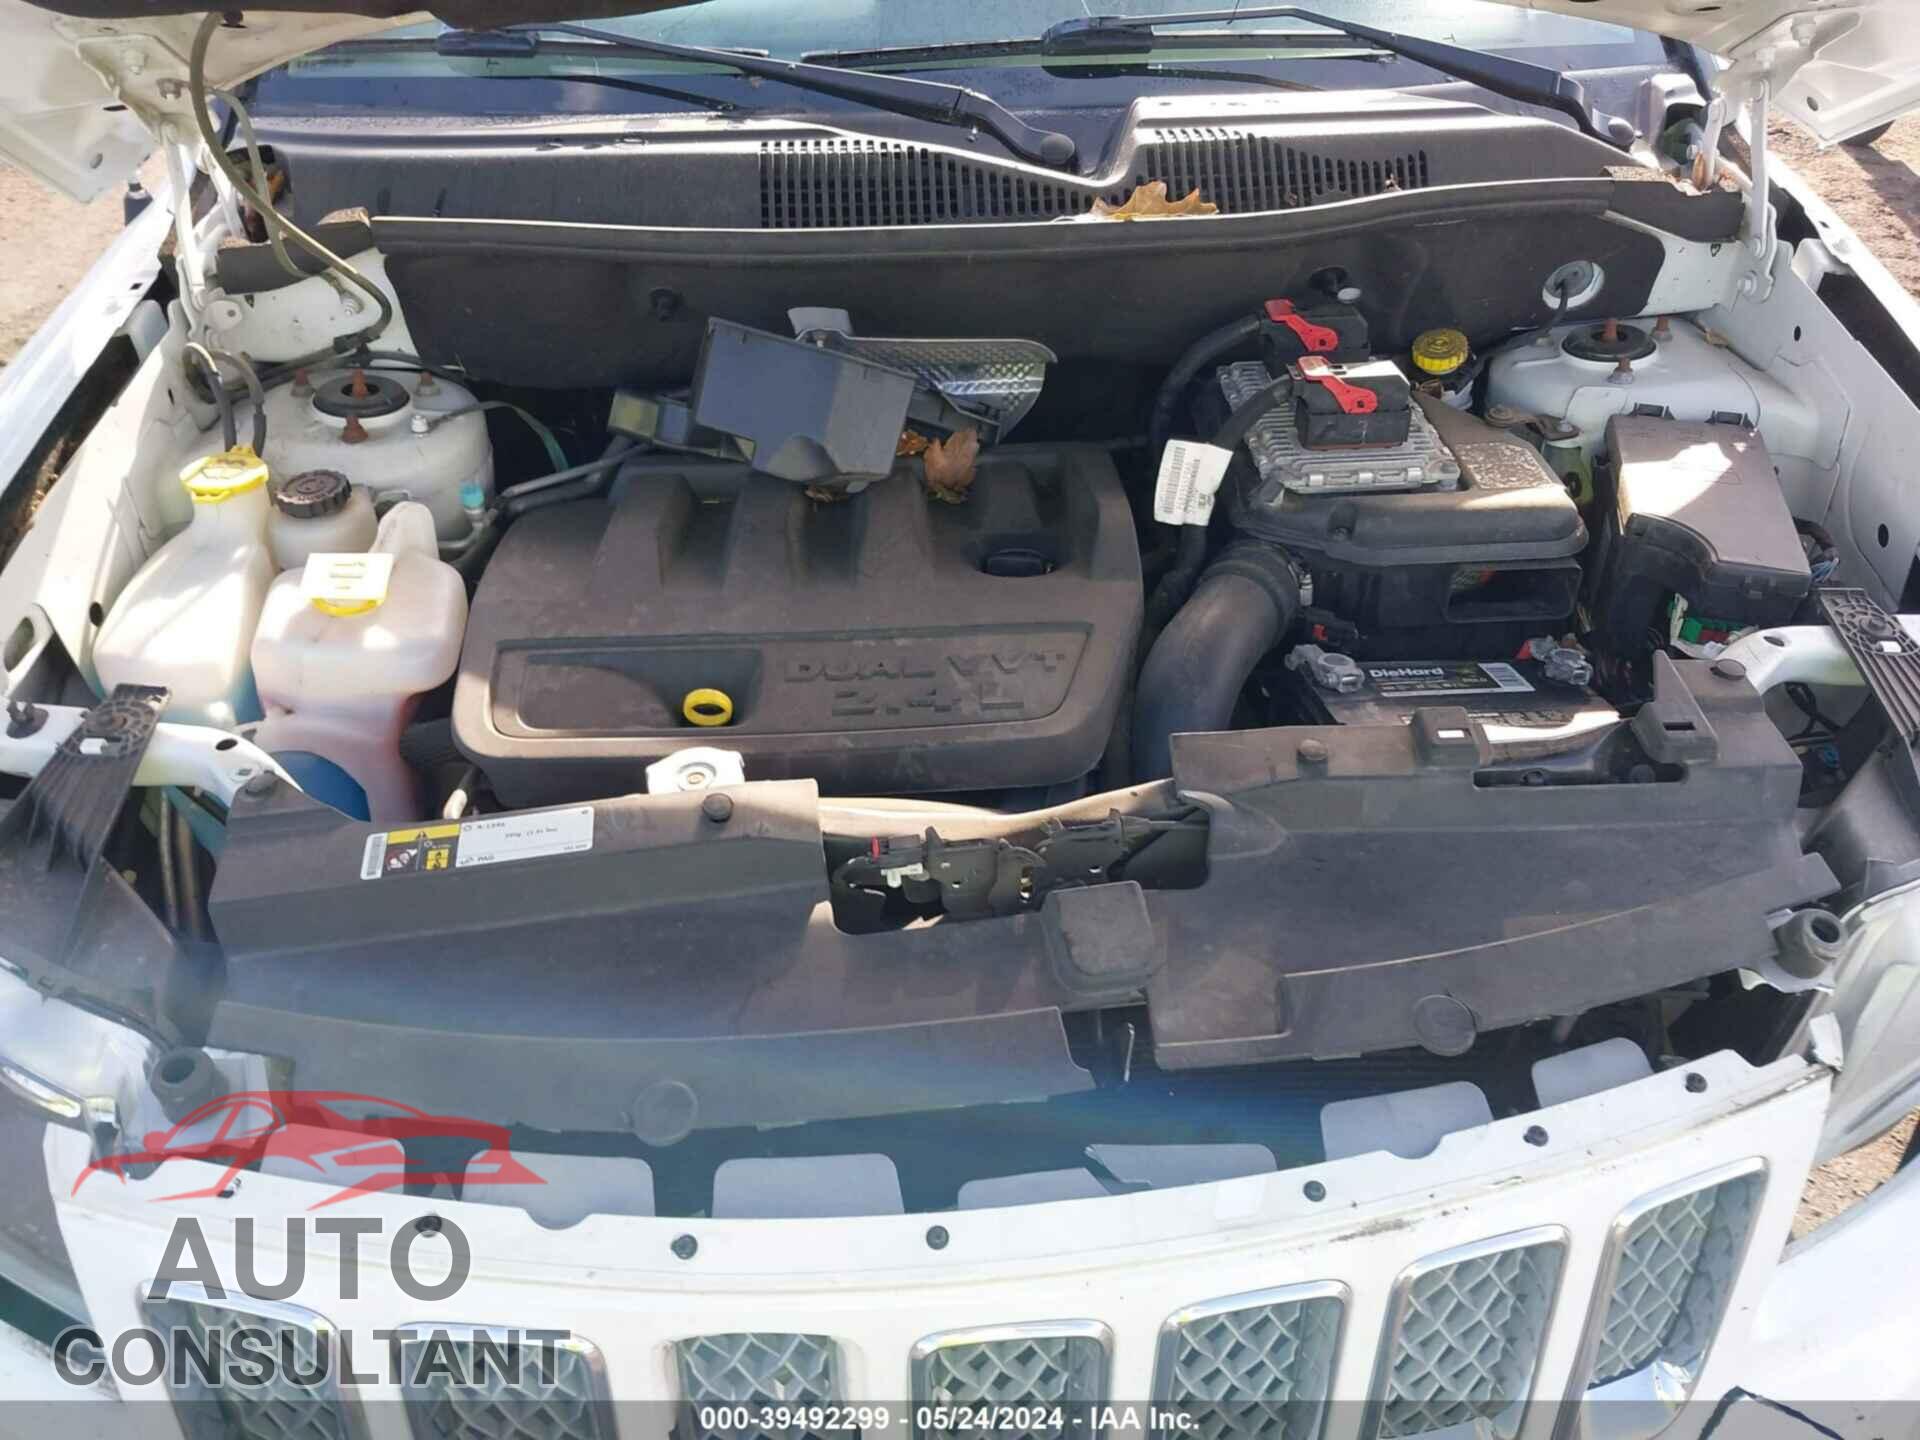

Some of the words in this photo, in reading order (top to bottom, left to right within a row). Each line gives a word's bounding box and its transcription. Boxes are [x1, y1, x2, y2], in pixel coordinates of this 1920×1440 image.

[784, 654, 936, 683] DUAL
[947, 653, 1065, 677] VVT
[1369, 667, 1444, 678] DieHard
